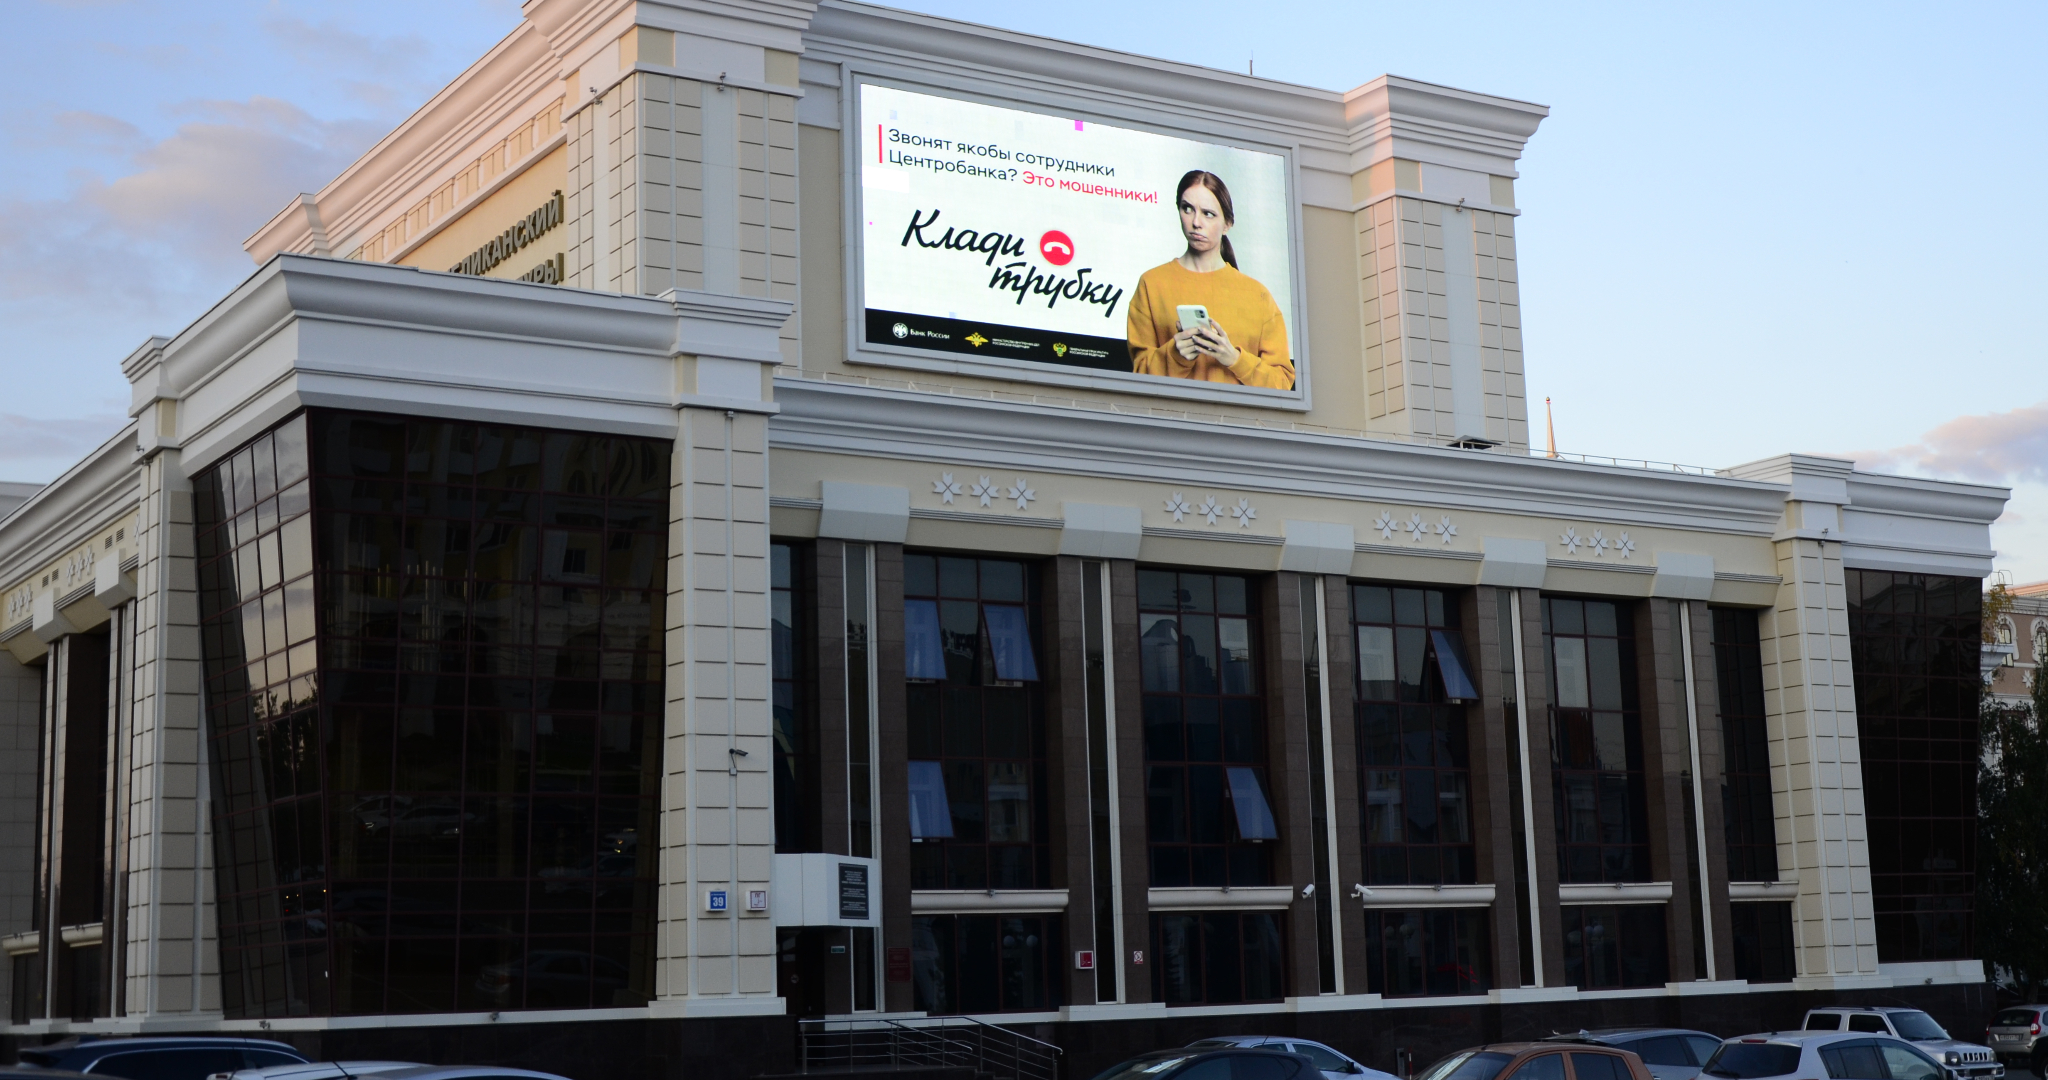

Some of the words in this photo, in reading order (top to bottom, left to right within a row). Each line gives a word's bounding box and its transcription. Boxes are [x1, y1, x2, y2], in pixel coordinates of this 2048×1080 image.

[888, 128, 952, 151] Звонят
[957, 141, 1011, 160] якобы
[1015, 150, 1115, 177] сотрудники
[889, 149, 1018, 182] Центробанка?
[1022, 170, 1055, 188] Это
[1059, 178, 1159, 205] мошенники!
[901, 209, 1025, 267] Клади
[988, 261, 1123, 318] трубку
[712, 896, 724, 907] 39
